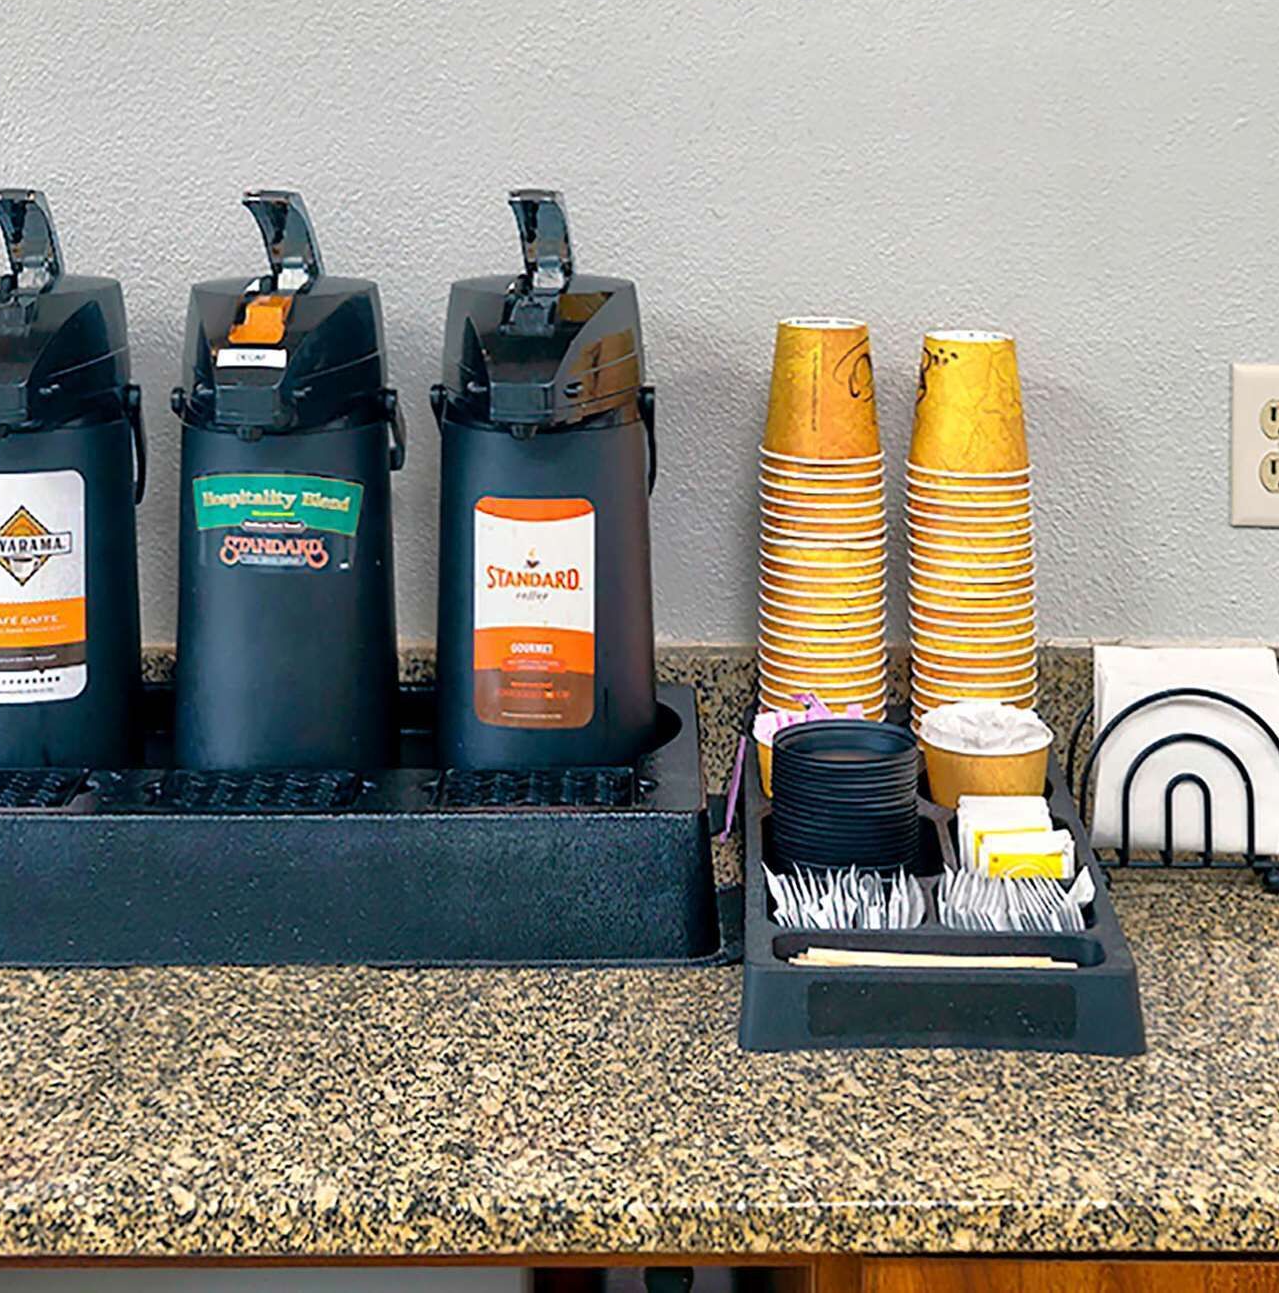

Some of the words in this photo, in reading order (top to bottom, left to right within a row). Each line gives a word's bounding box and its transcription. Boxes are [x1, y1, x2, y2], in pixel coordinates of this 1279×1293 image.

[202, 488, 297, 510] Hospitality
[220, 535, 329, 569] STANDARD
[486, 564, 579, 591] STANDARD
